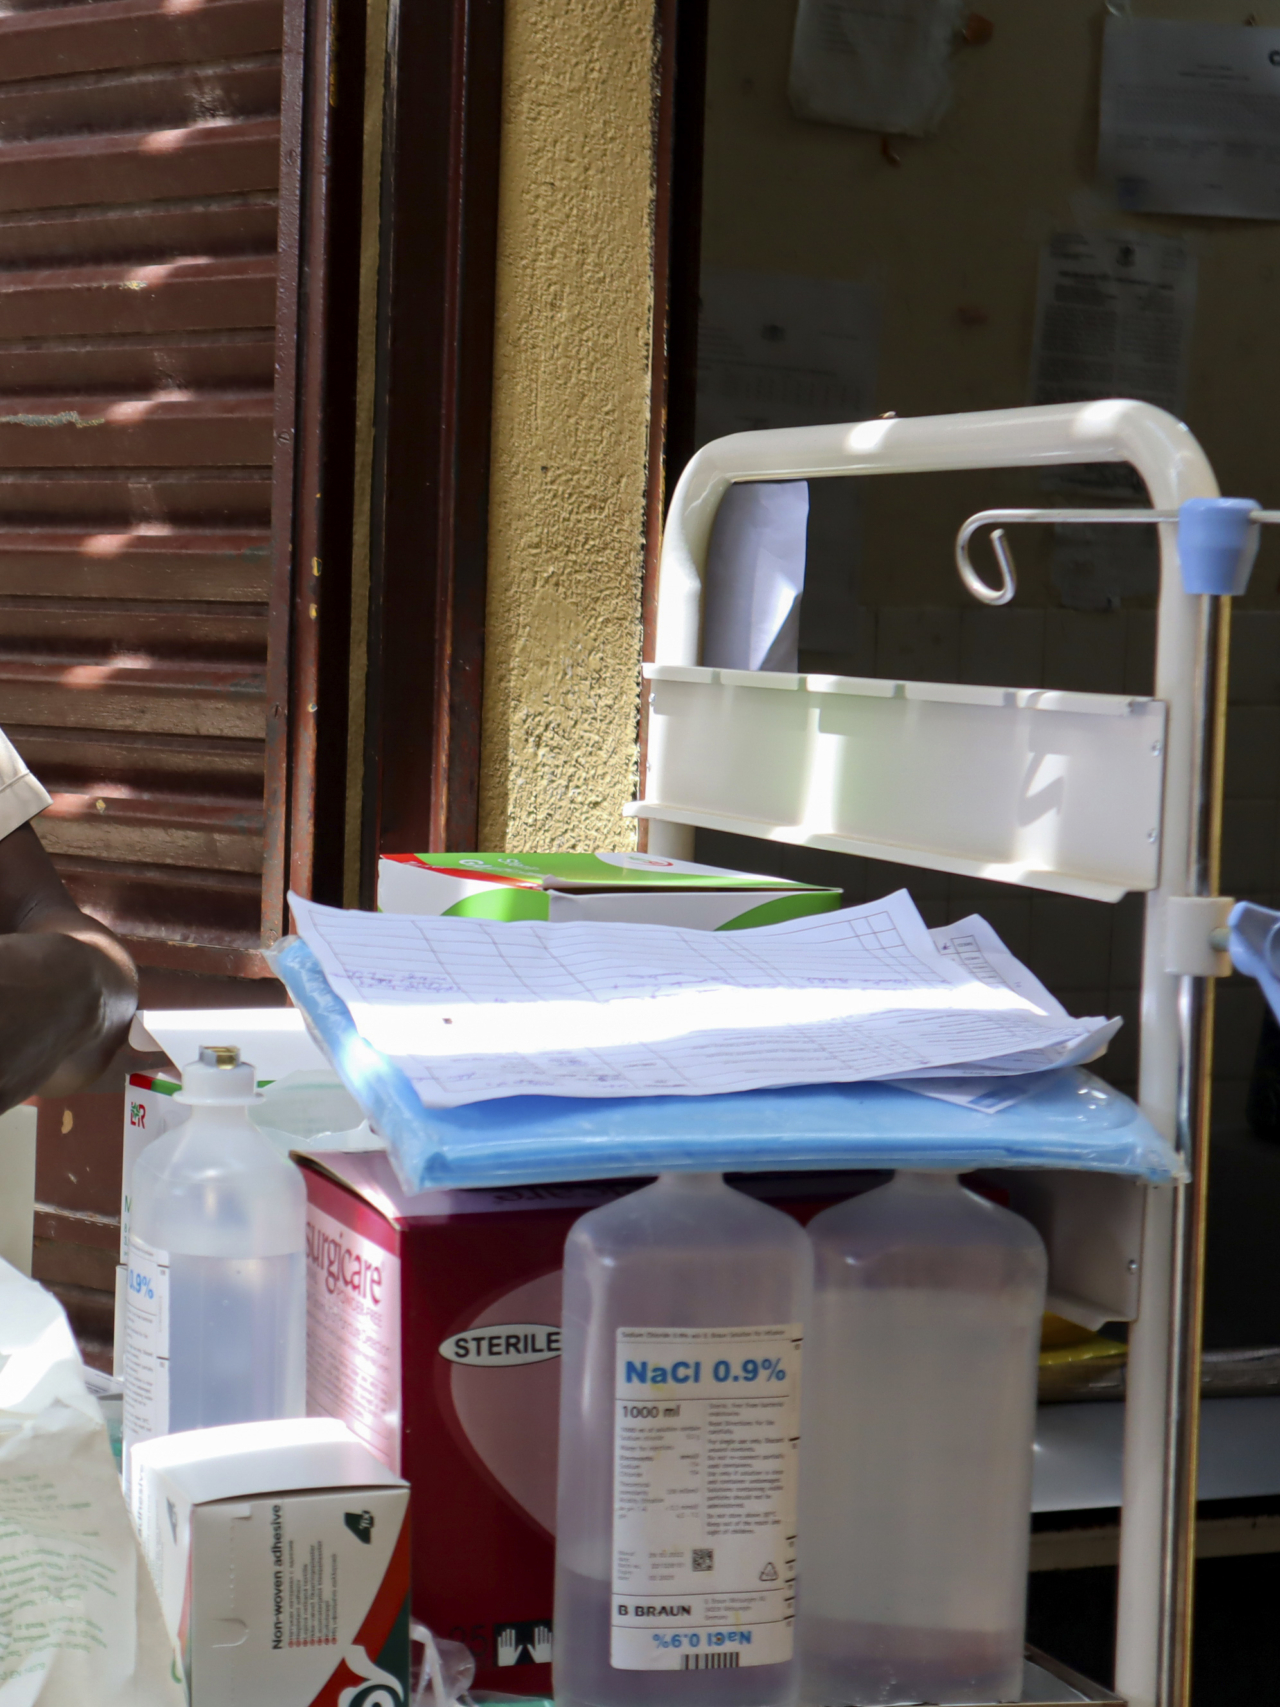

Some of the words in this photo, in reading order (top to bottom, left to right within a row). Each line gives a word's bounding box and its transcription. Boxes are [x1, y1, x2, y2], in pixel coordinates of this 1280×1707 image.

[305, 1221, 383, 1305] surgicare
[454, 1331, 562, 1358] STERILE
[624, 1360, 701, 1384] NaCl
[713, 1357, 787, 1383] 0.9%
[622, 1405, 660, 1419] 1000
[663, 1404, 681, 1418] ml
[270, 1504, 283, 1567] adhesive
[270, 1571, 283, 1650] Non-woven
[618, 1605, 629, 1617] B
[634, 1605, 692, 1617] BRAUN
[652, 1633, 701, 1649] 0.9%
[706, 1630, 753, 1646] NaCl
